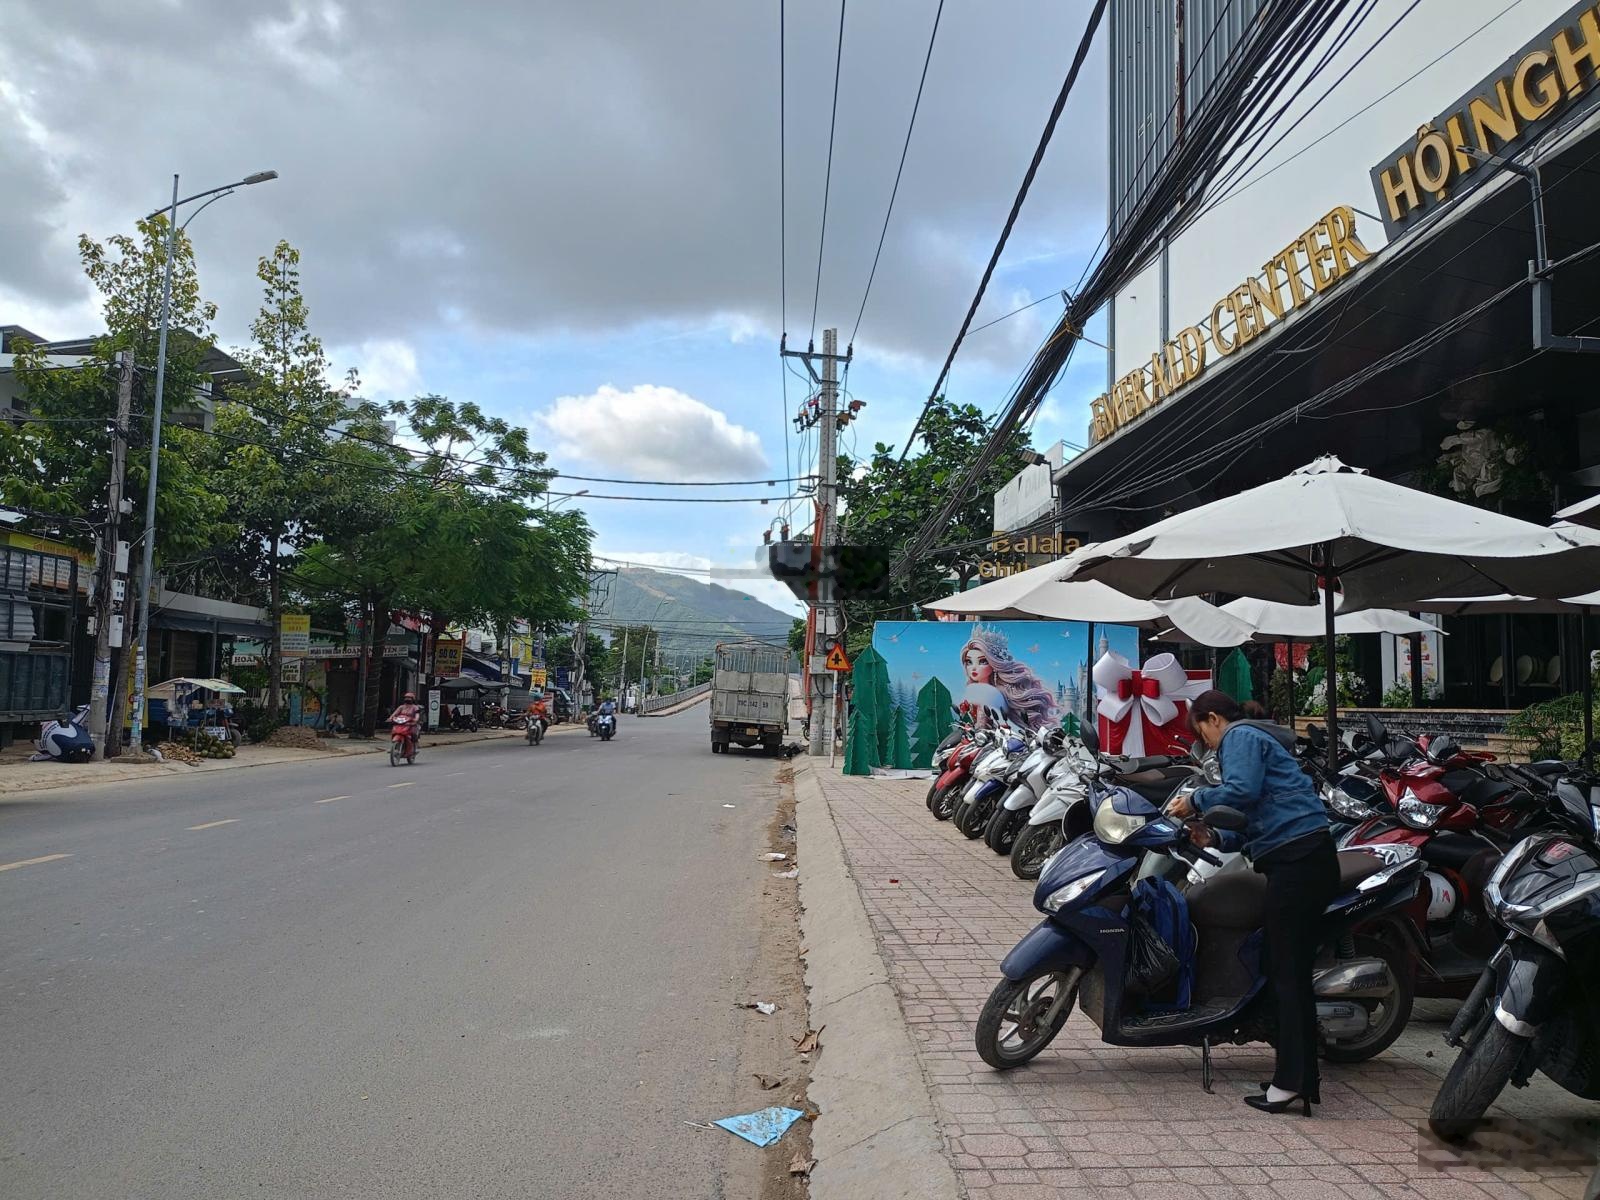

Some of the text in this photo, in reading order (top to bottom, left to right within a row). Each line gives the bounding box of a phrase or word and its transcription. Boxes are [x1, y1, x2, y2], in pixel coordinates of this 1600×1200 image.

[1468, 6, 1600, 154] NGH
[1090, 205, 1375, 442] EMERALD CENTER
